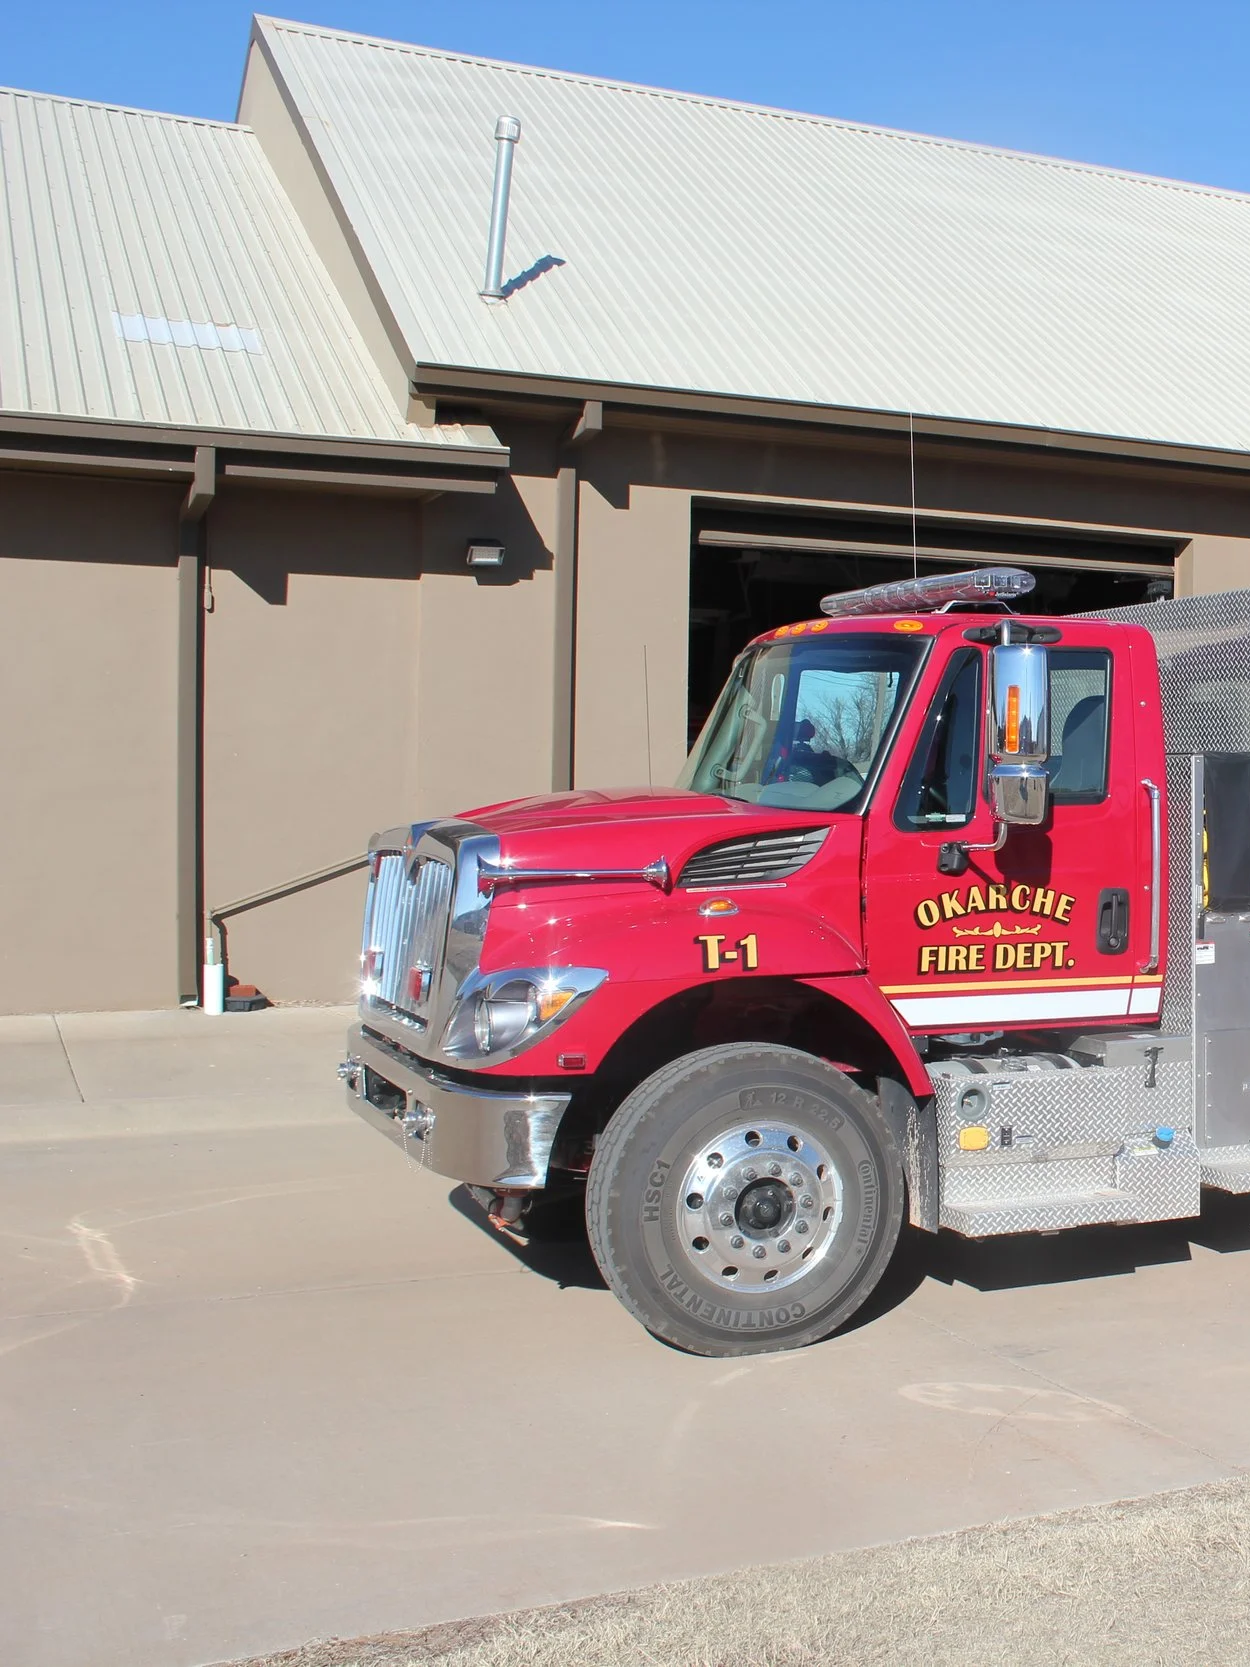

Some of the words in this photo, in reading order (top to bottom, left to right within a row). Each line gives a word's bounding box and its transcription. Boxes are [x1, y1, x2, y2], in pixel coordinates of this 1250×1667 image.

[915, 884, 1076, 928] OKARCHE
[696, 934, 759, 971] T-1
[919, 945, 986, 974] FIRE
[995, 941, 1075, 970] DEPT.
[770, 1091, 787, 1105] 12
[811, 1103, 842, 1129] 22.5
[643, 1159, 672, 1223] HSC1
[857, 1159, 878, 1245] Continental
[660, 1263, 807, 1328] CONTINENTAL
